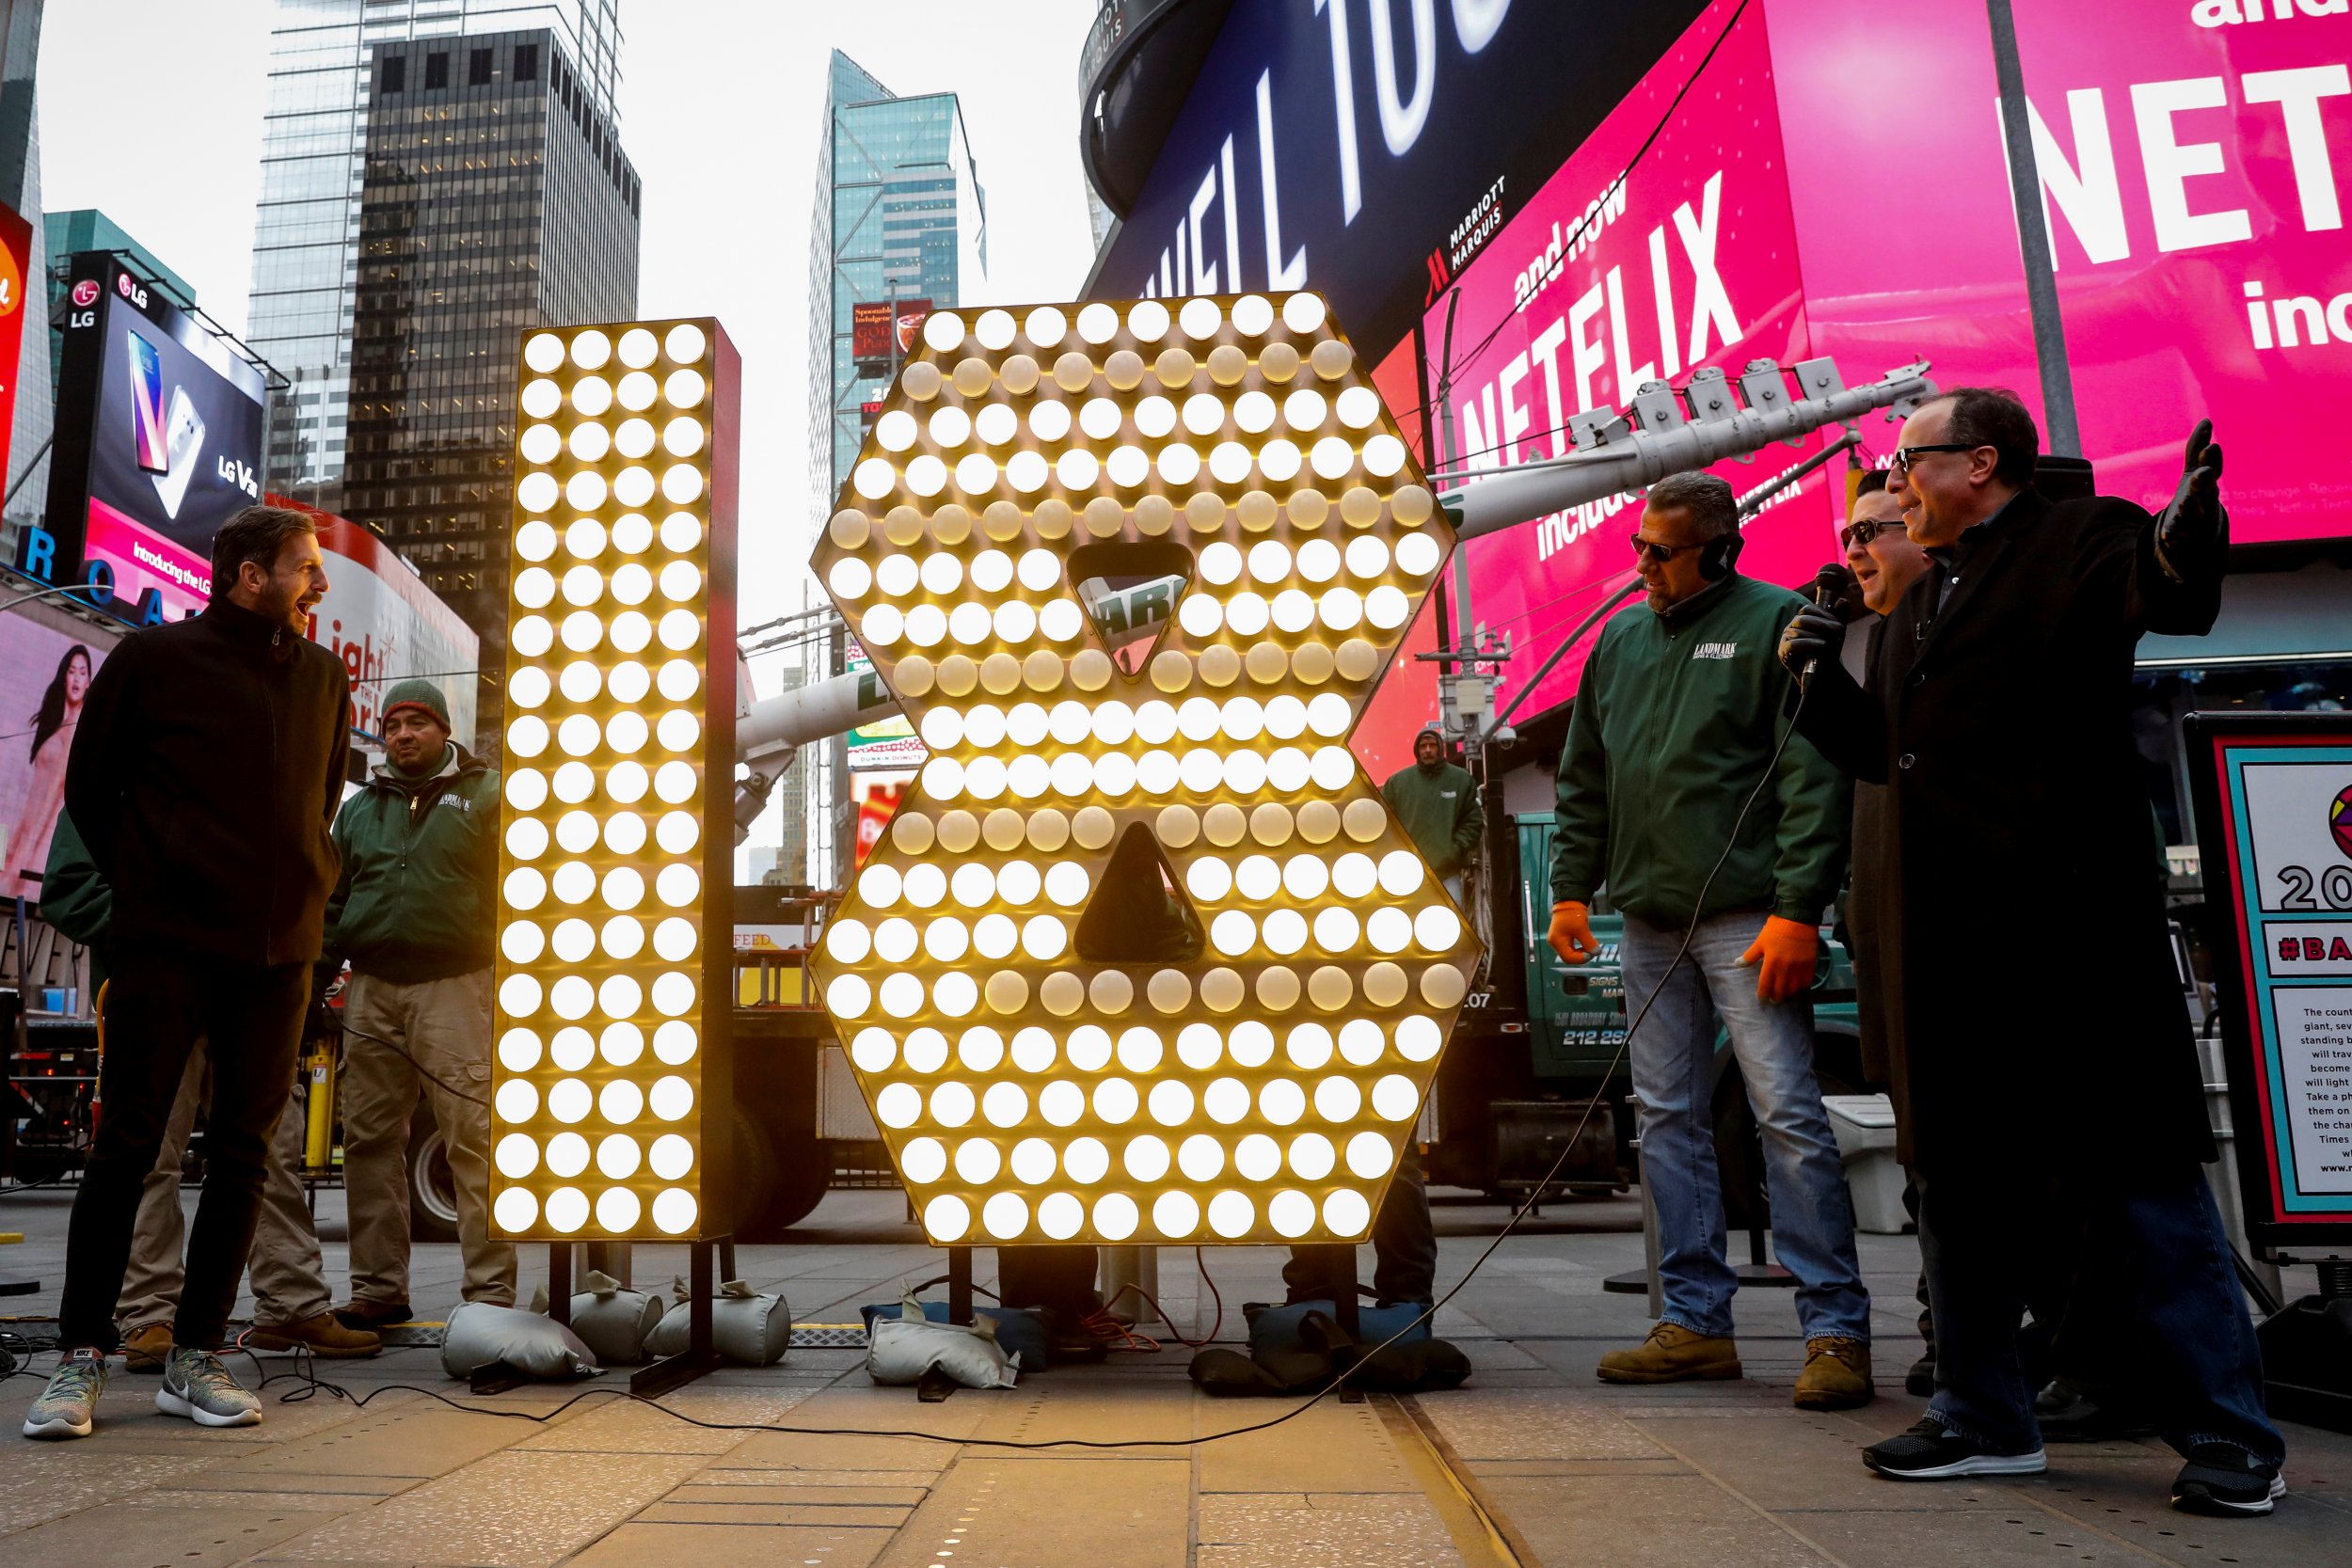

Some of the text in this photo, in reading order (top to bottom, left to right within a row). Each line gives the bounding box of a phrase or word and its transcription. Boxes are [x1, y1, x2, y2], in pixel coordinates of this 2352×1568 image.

[1450, 175, 1505, 249] MARRIOTT
[1452, 207, 1502, 271] MARQUIS
[1514, 169, 1627, 313] and now
[131, 284, 148, 309] LG
[855, 307, 892, 317] Spoonabl
[71, 311, 95, 328] LG
[857, 326, 893, 339] GOD
[1463, 169, 1744, 486] NETFLIX
[218, 455, 236, 483] LG
[134, 542, 211, 595] Introducing the LG
[1694, 641, 1738, 656] LANDMARK
[1589, 976, 1619, 987] SIGNS
[2303, 1008, 2322, 1017] The
[2304, 1022, 2352, 1032] giant, sev
[2300, 1036, 2344, 1046] standing
[2312, 1050, 2330, 1059] will
[2311, 1064, 2350, 1073] become
[2305, 1078, 2349, 1088] will light
[2306, 1092, 2329, 1101] Take
[2308, 1106, 2334, 1116] them
[2312, 1120, 2329, 1130] the
[2319, 1135, 2349, 1144] Times
